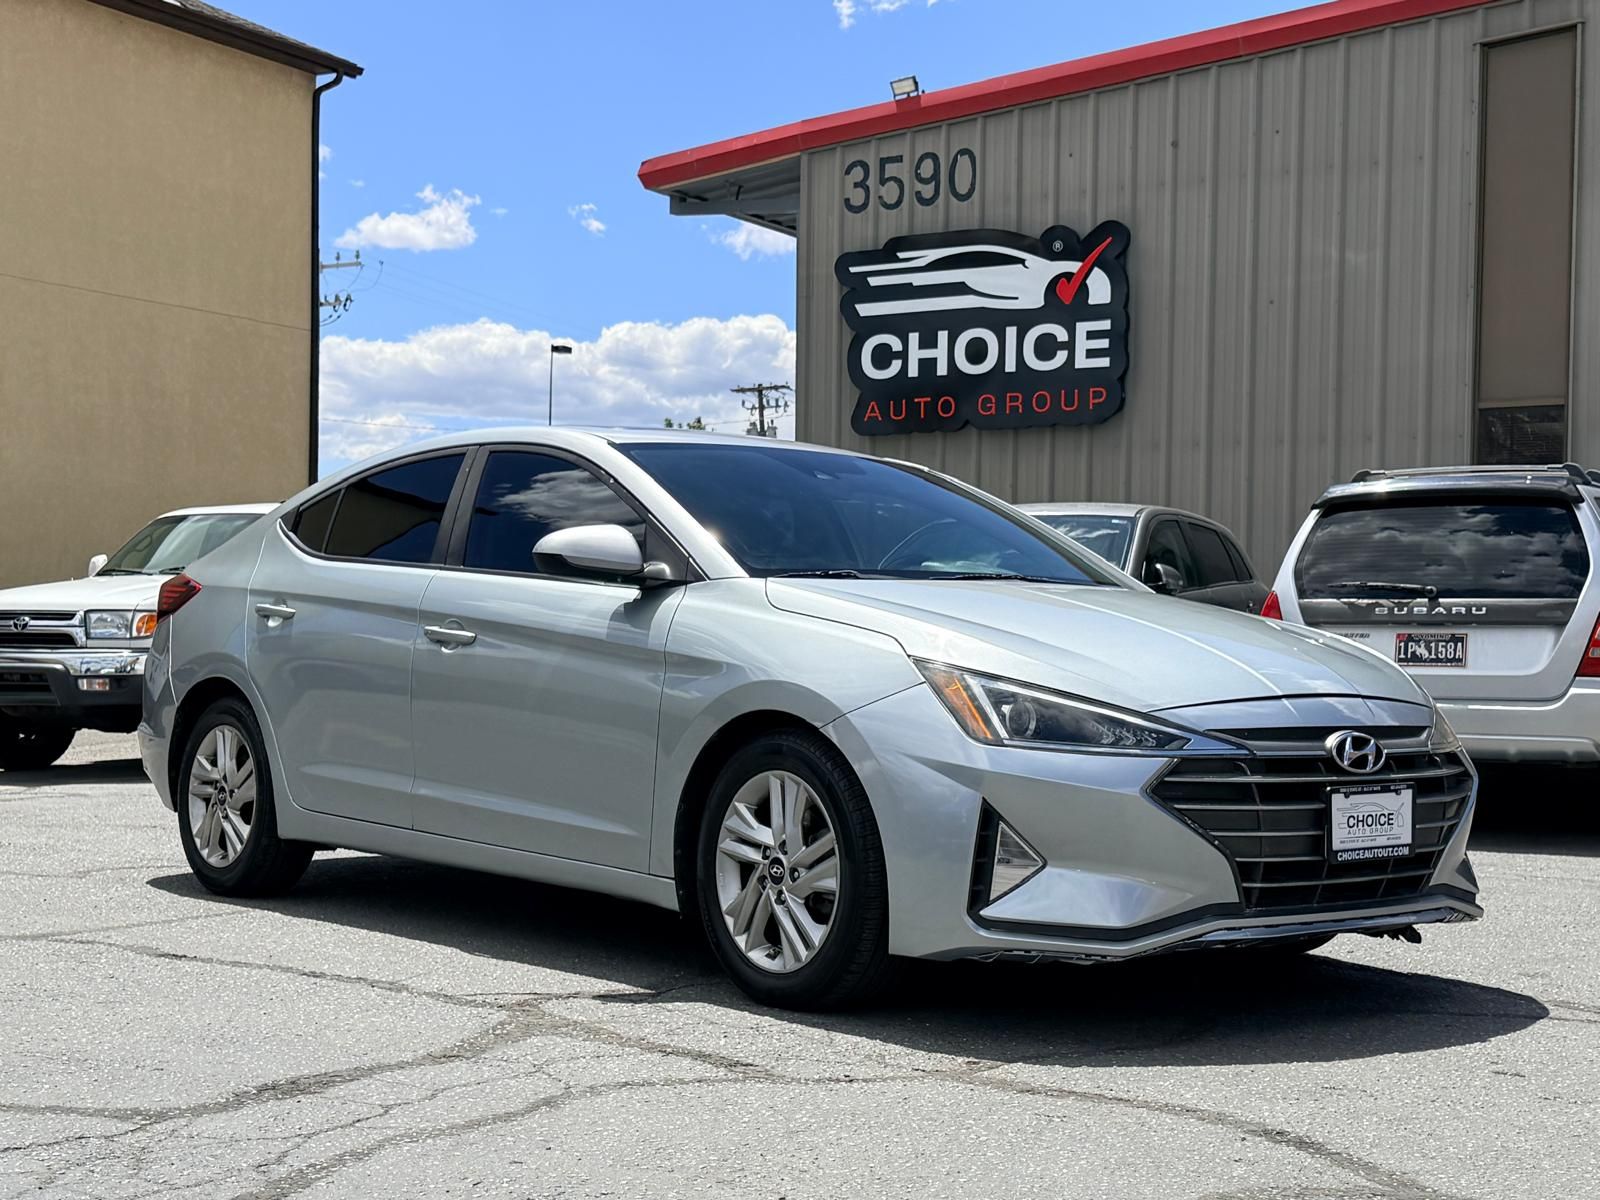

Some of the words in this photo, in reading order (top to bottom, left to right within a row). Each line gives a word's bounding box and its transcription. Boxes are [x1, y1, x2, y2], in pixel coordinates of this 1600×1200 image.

[843, 148, 977, 213] 3590
[860, 319, 1112, 380] CHOICE
[863, 396, 956, 422] AUTO
[977, 387, 1108, 416] GROUP
[1374, 606, 1487, 615] SUBARU
[1398, 642, 1416, 659] 1P
[1429, 642, 1463, 659] 158A
[1346, 812, 1395, 829] CHOICE
[1369, 826, 1394, 835] GROUP
[1337, 846, 1409, 861] CHOICEAUTOUT.COM
